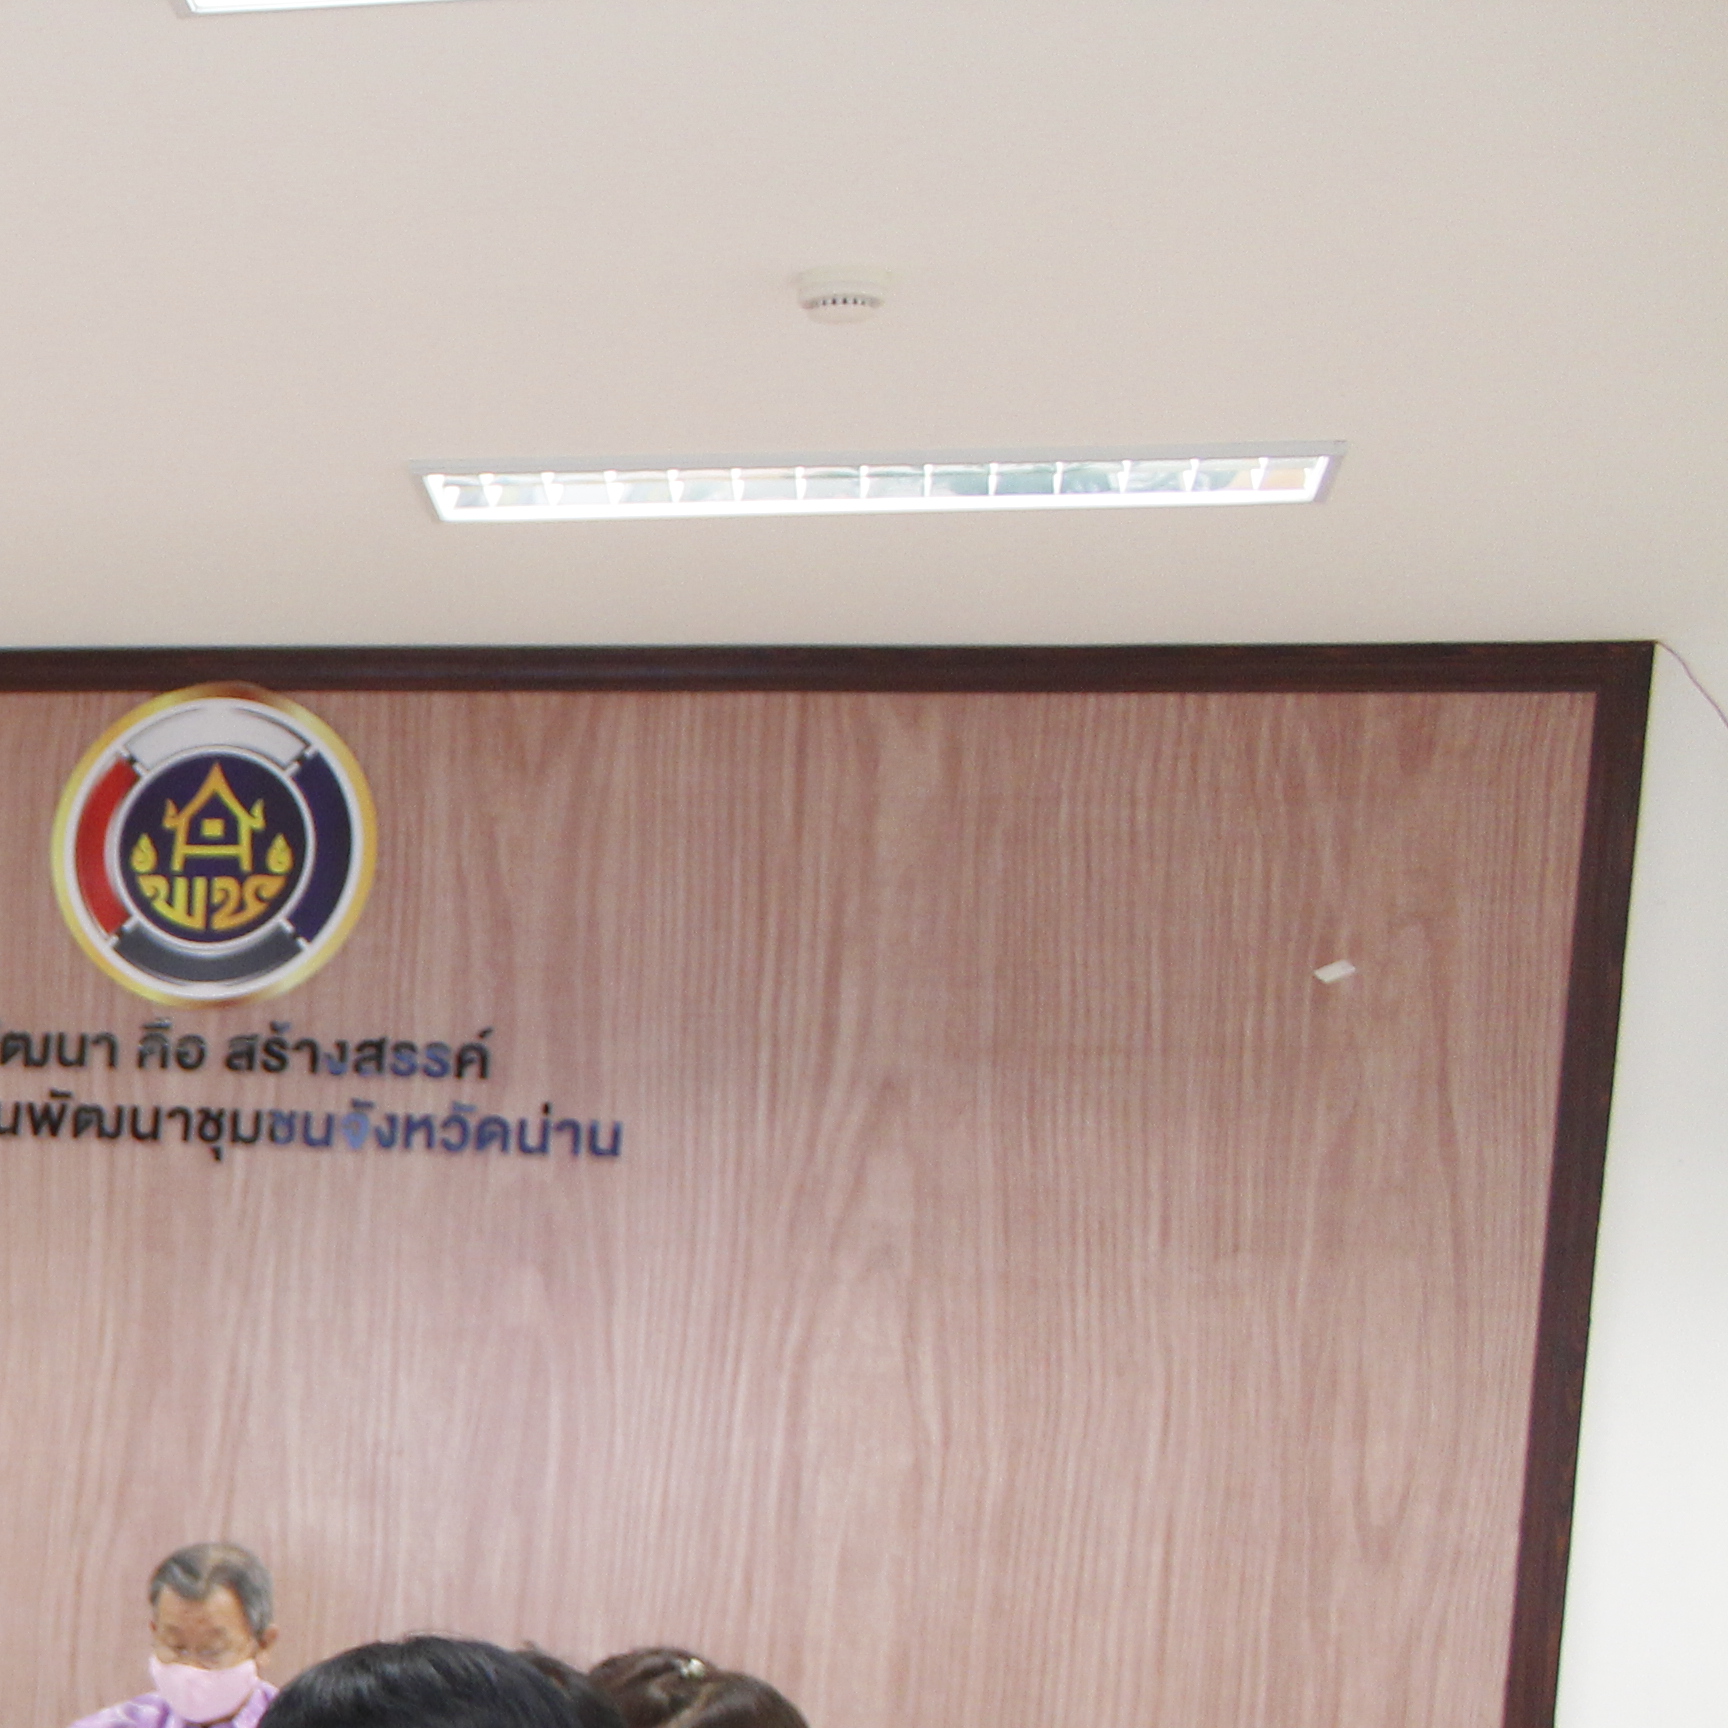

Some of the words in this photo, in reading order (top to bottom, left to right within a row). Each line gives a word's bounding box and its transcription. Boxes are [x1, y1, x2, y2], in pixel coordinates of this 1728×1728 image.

[137, 1016, 206, 1070] คือ
[224, 1020, 493, 1079] สร้างสรรค์
